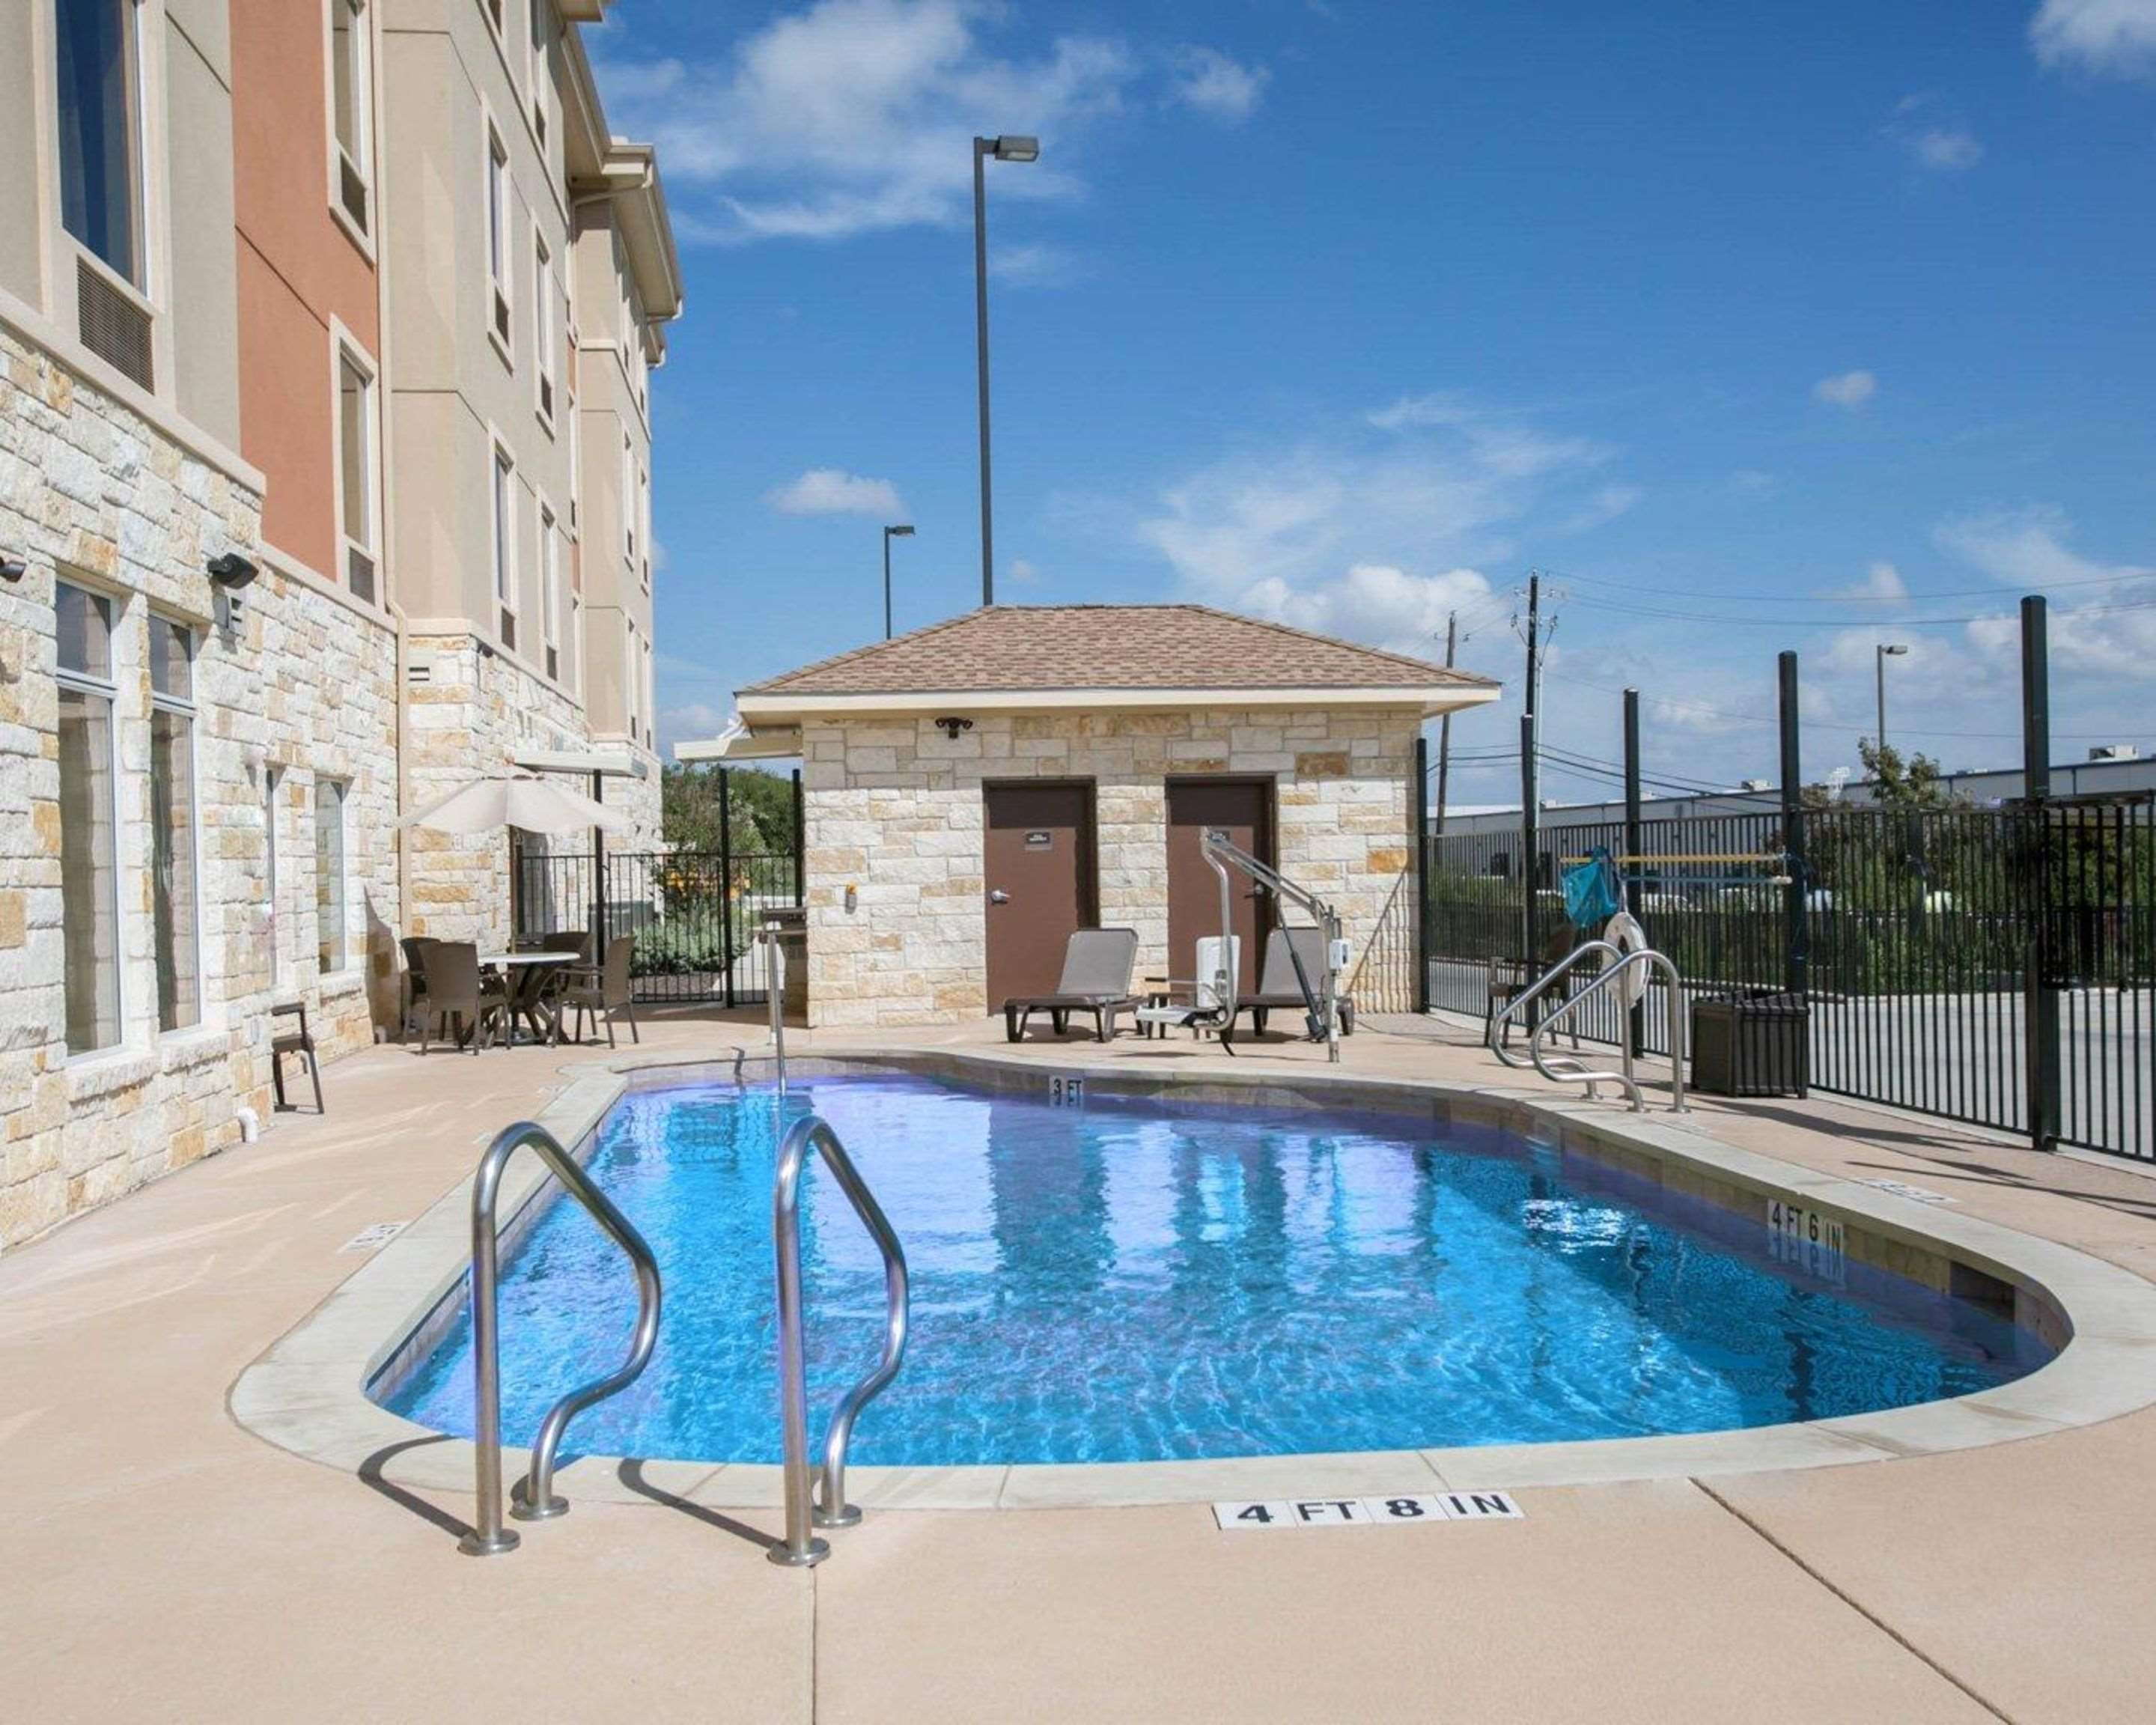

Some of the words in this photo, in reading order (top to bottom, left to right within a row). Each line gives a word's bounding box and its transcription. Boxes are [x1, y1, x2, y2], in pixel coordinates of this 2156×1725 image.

[1053, 1078, 1062, 1094] 3
[1067, 1080, 1082, 1095] FT
[1773, 1202, 1782, 1230] 4
[1787, 1206, 1803, 1236] FT
[1809, 1214, 1818, 1241] 6
[1827, 1223, 1840, 1252] IN
[1237, 1504, 1273, 1523] 4
[1297, 1500, 1356, 1521] FT
[1386, 1499, 1424, 1517] 8
[1448, 1495, 1511, 1514] IN
